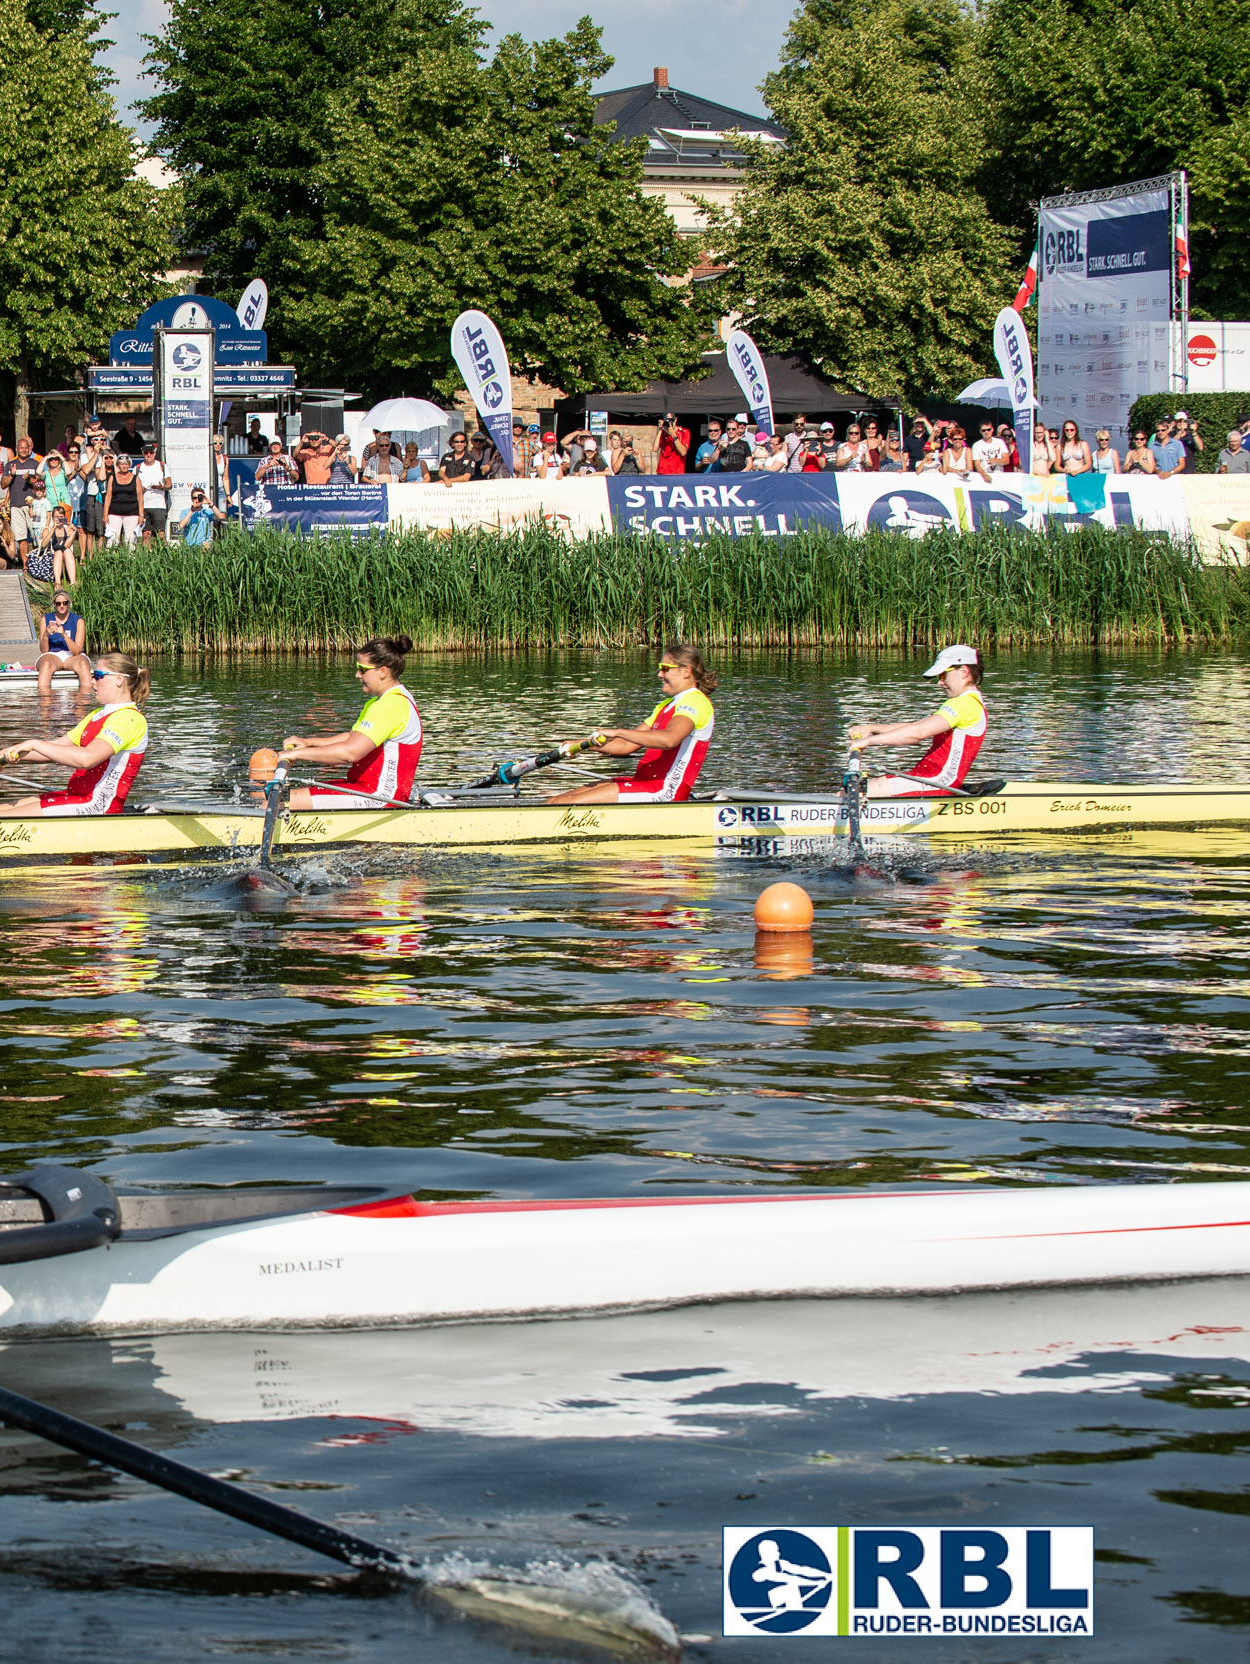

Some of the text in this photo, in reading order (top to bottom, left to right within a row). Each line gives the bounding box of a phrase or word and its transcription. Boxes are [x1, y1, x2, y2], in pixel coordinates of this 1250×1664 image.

[1057, 229, 1084, 264] RBL
[1088, 251, 1147, 272] STARK. SCHNELL. GUT.
[241, 293, 261, 330] BL
[119, 339, 154, 353] Rittm
[99, 375, 153, 383] Seestraße 9 1454
[172, 377, 201, 389] RBL
[624, 485, 756, 508] STARK.
[628, 514, 808, 536] SCHNELL.
[741, 806, 926, 822] RBL RUDER-BNDESLIGA
[937, 801, 1007, 816] Z BS 001
[1049, 800, 1133, 812] Erich Domeier
[282, 814, 329, 835] Melitta
[552, 808, 601, 829] Melitta
[258, 1257, 345, 1276] MEDALIST
